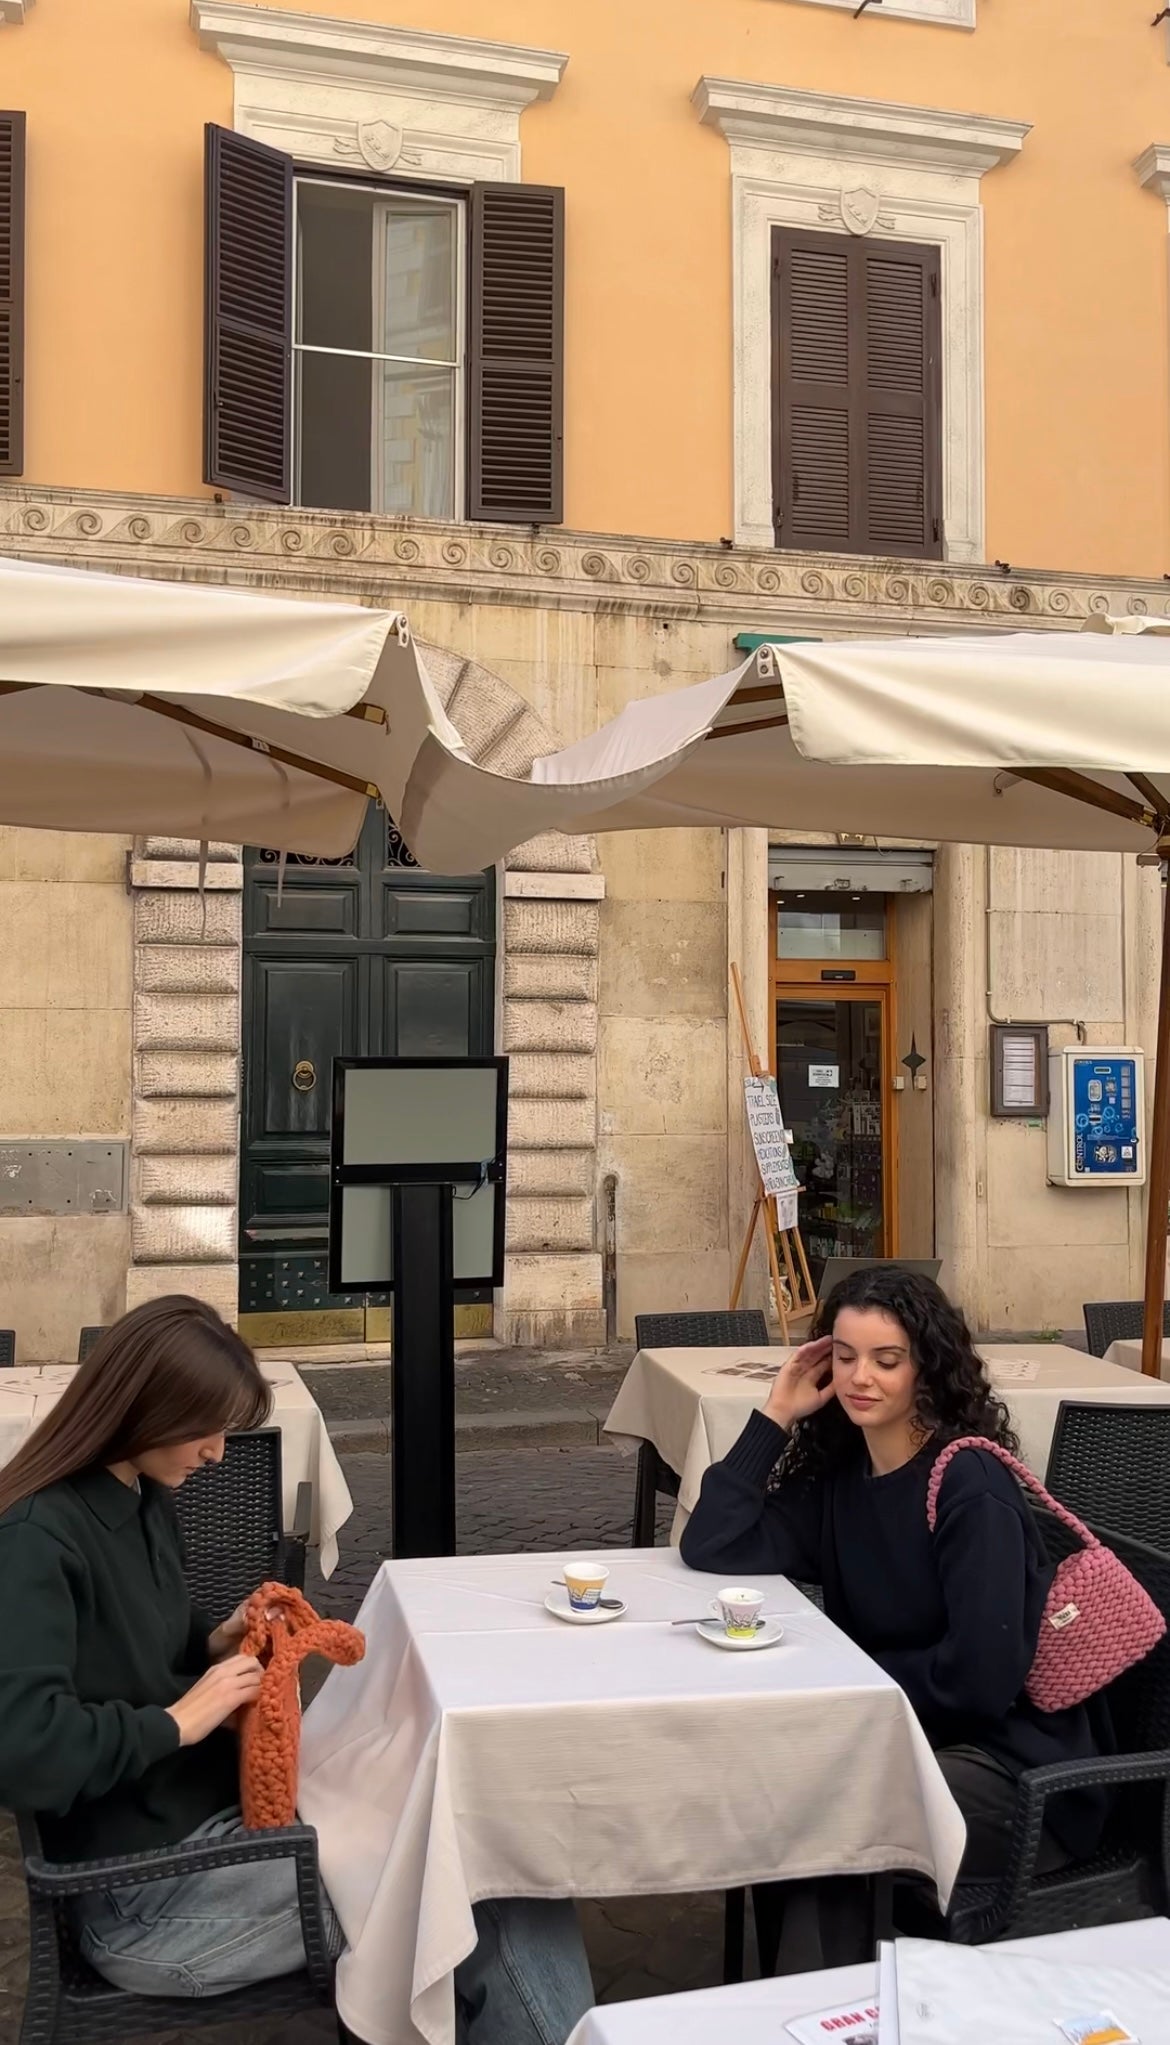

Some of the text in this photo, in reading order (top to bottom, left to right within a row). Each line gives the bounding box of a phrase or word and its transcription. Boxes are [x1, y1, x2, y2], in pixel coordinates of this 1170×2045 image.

[750, 1112, 775, 1126] PLASTERS
[754, 1129, 784, 1145] SUNSCREEN
[820, 2005, 879, 2030] GRAN C
